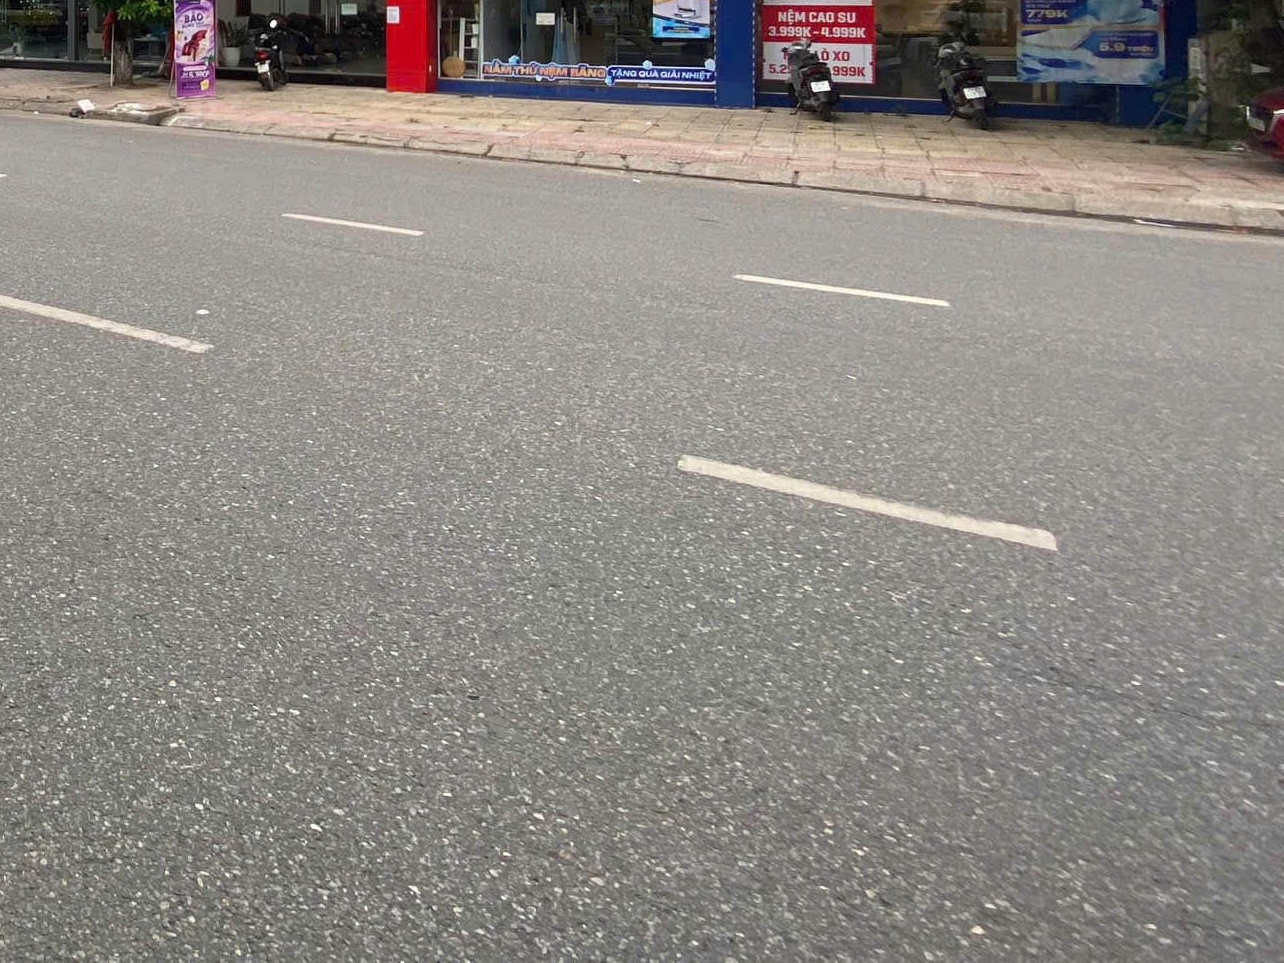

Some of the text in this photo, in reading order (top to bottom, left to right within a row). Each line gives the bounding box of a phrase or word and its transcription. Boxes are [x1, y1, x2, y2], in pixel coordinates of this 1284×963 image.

[778, 9, 857, 25] NỆM CAO SU
[768, 26, 812, 38] 3.999K
[821, 27, 866, 38] 4.999K
[833, 51, 851, 62] XO
[638, 68, 659, 79] QUÀ
[681, 69, 712, 81] NHIỆT
[830, 66, 866, 77] .999K
